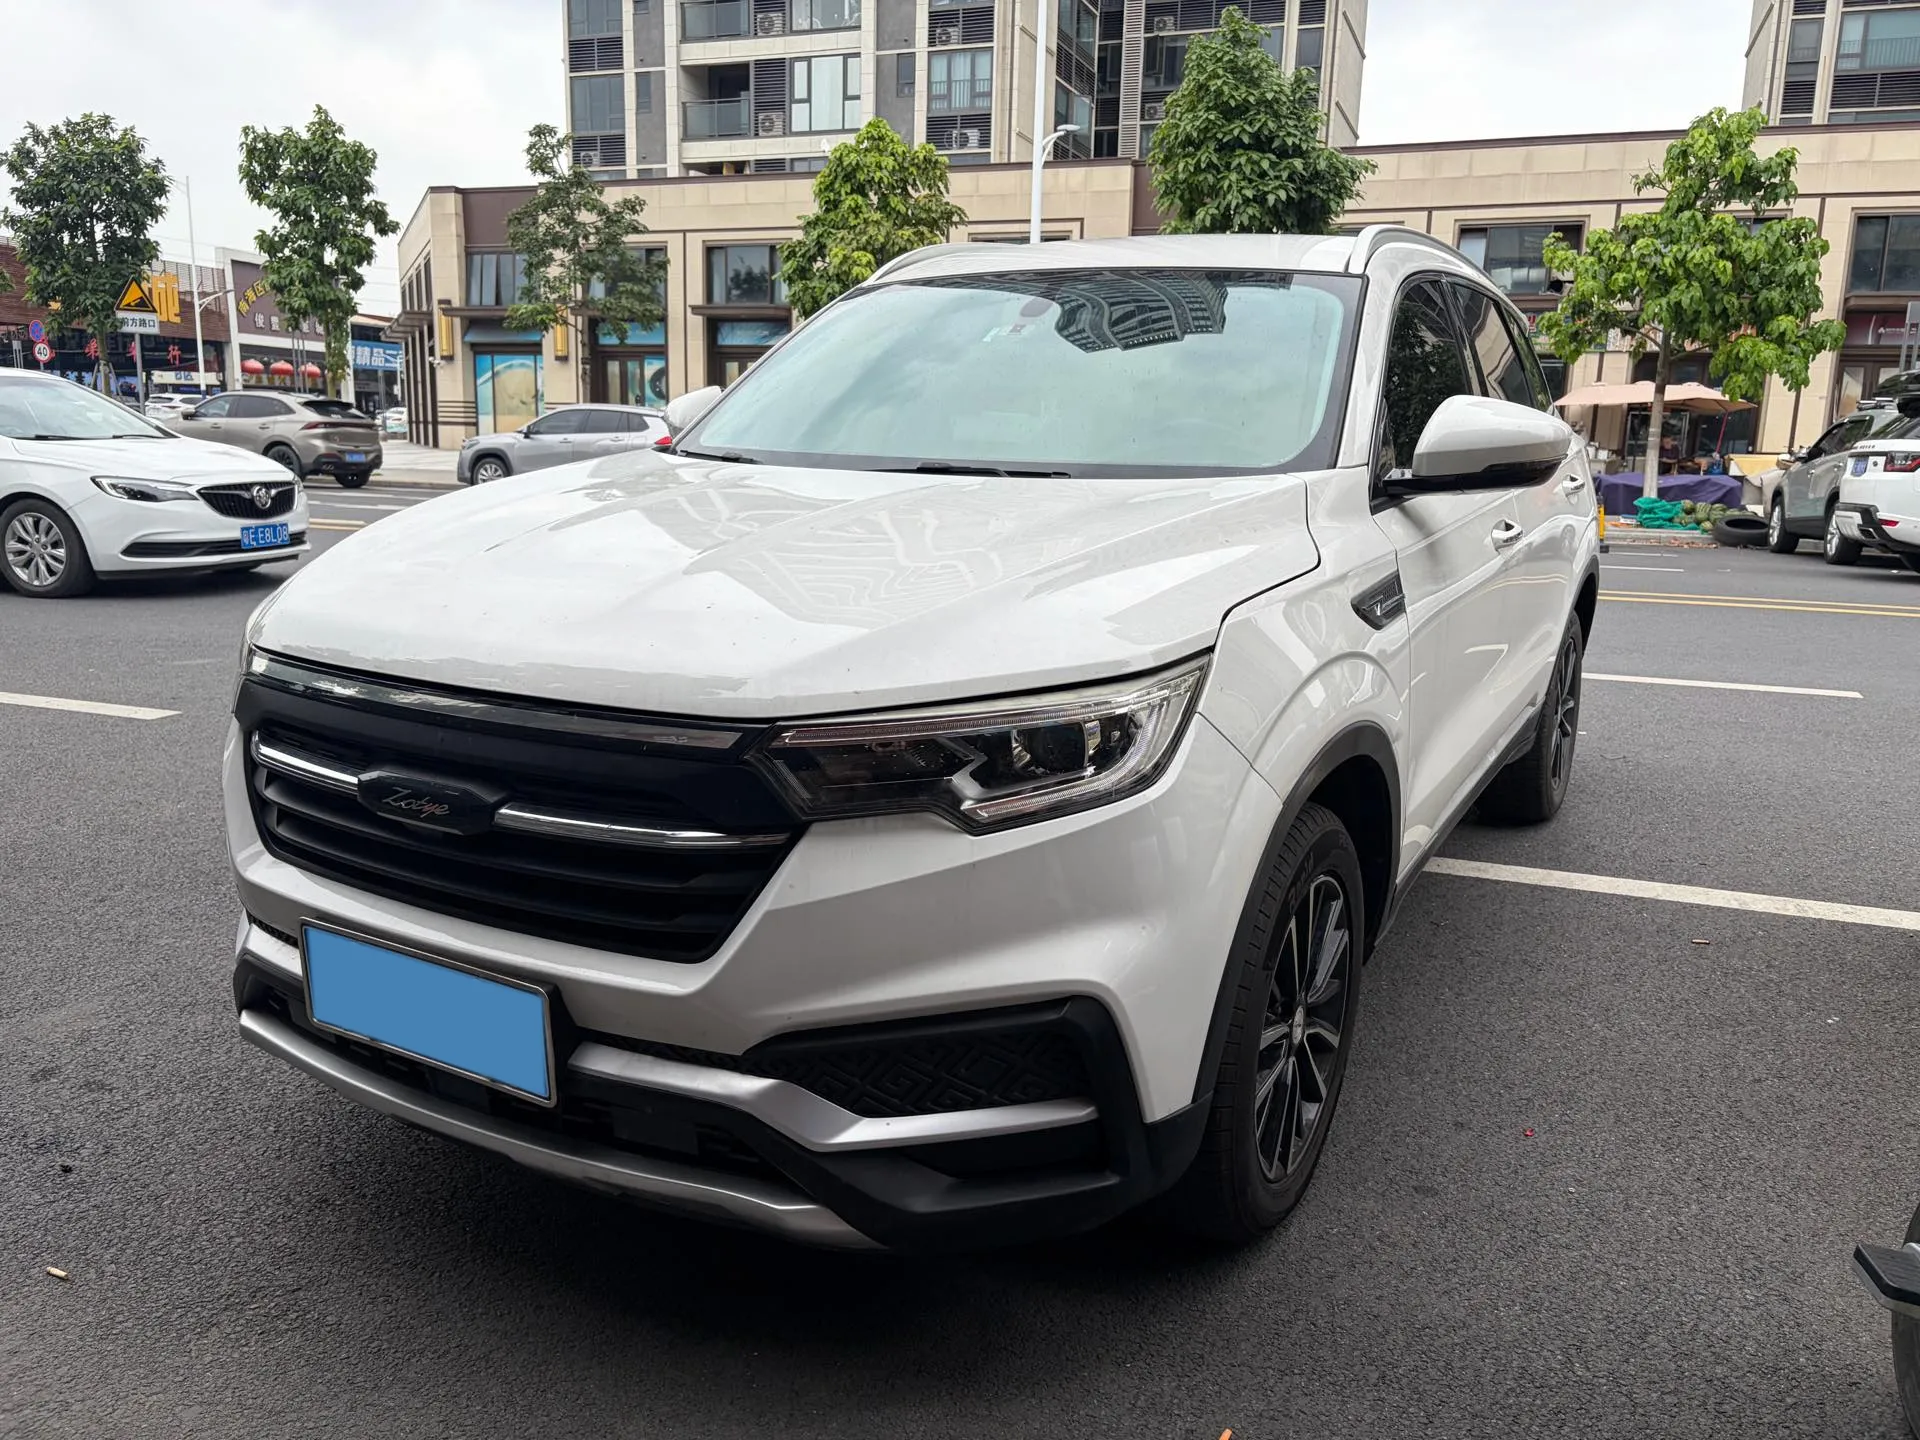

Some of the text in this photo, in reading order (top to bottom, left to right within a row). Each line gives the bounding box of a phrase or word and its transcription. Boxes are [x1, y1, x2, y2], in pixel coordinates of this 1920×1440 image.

[121, 317, 156, 328] 前方路口
[37, 347, 48, 357] 40
[382, 786, 450, 818] Zotye
